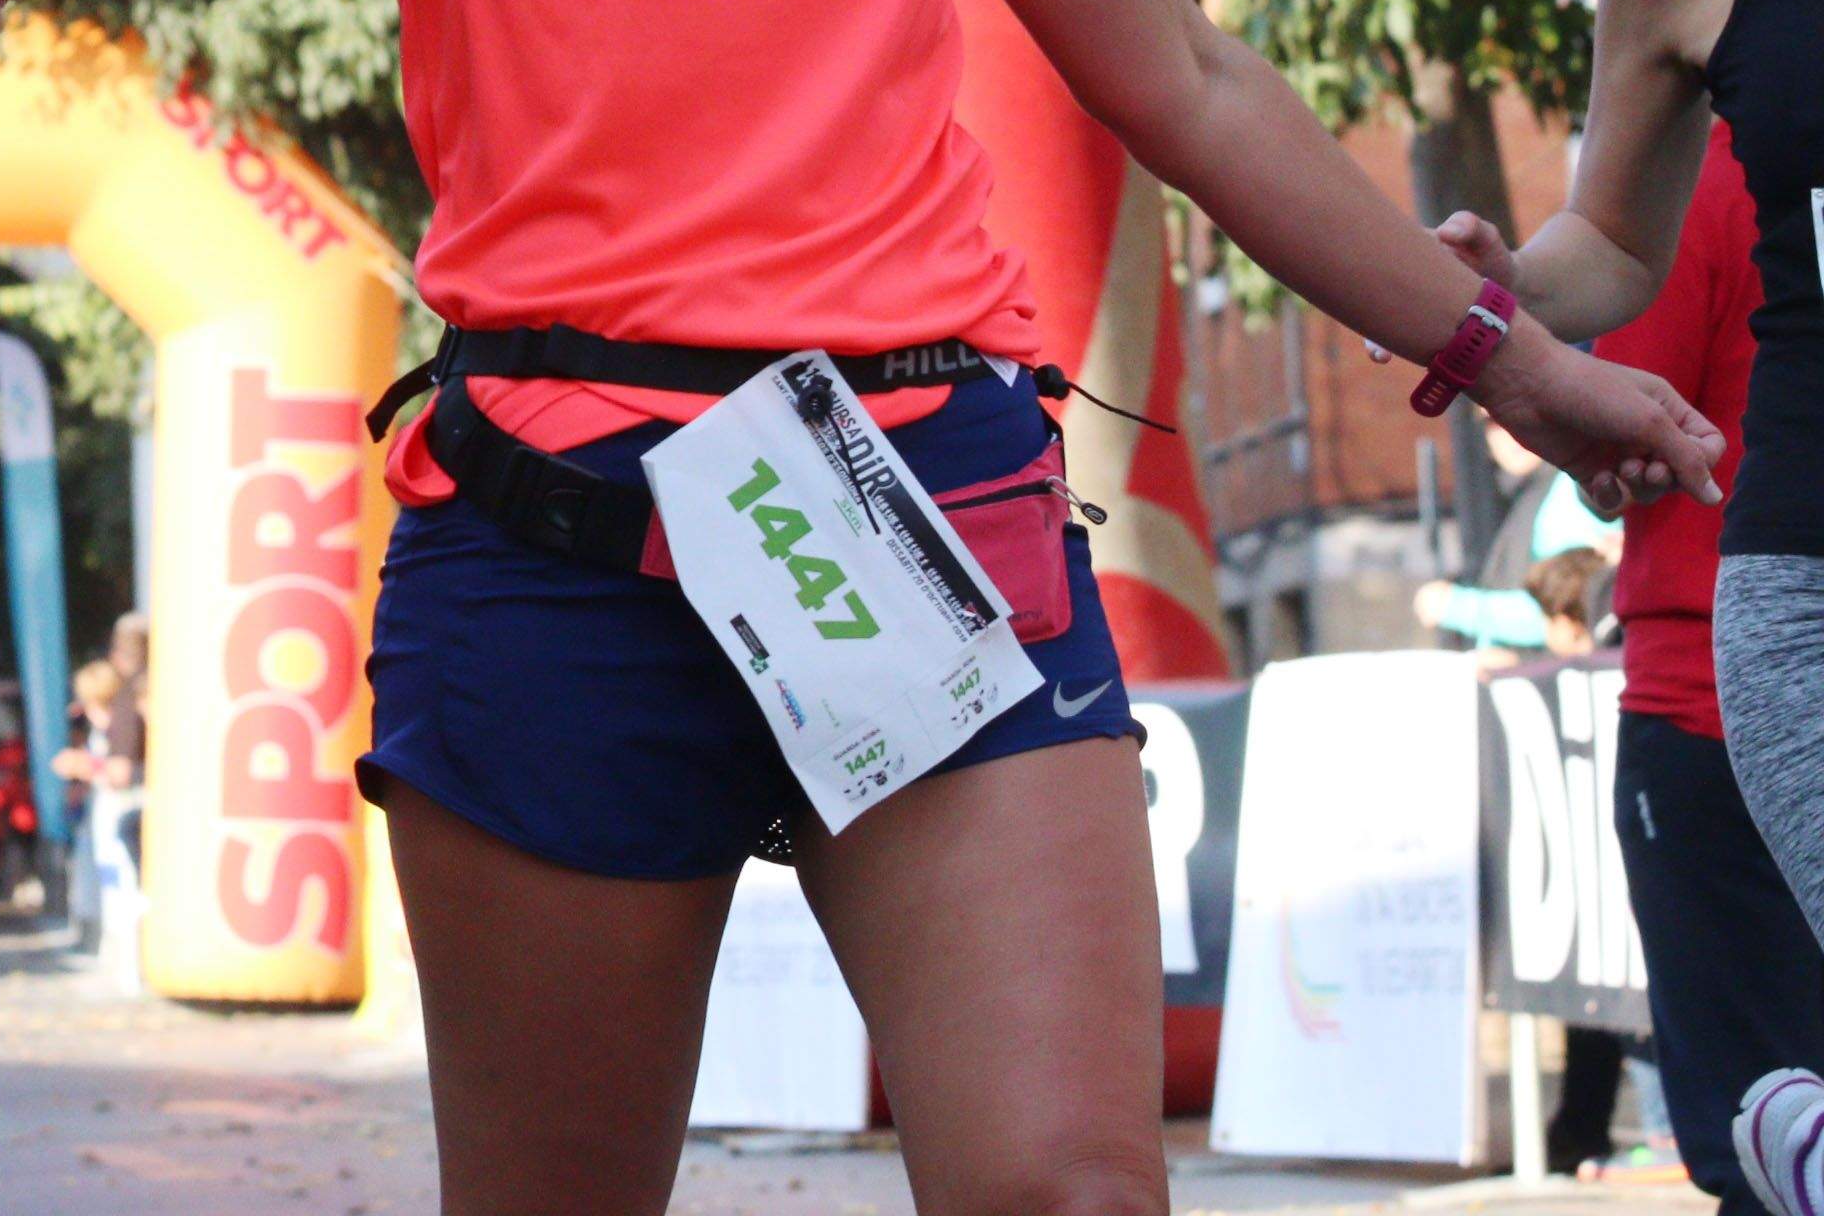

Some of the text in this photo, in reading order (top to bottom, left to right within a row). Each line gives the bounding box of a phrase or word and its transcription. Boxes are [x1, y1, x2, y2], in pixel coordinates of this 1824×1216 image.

[836, 434, 898, 499] DiR
[726, 456, 881, 640] 1447
[216, 367, 360, 954] SPORT
[949, 667, 982, 702] 1447
[843, 739, 887, 776] 1447
